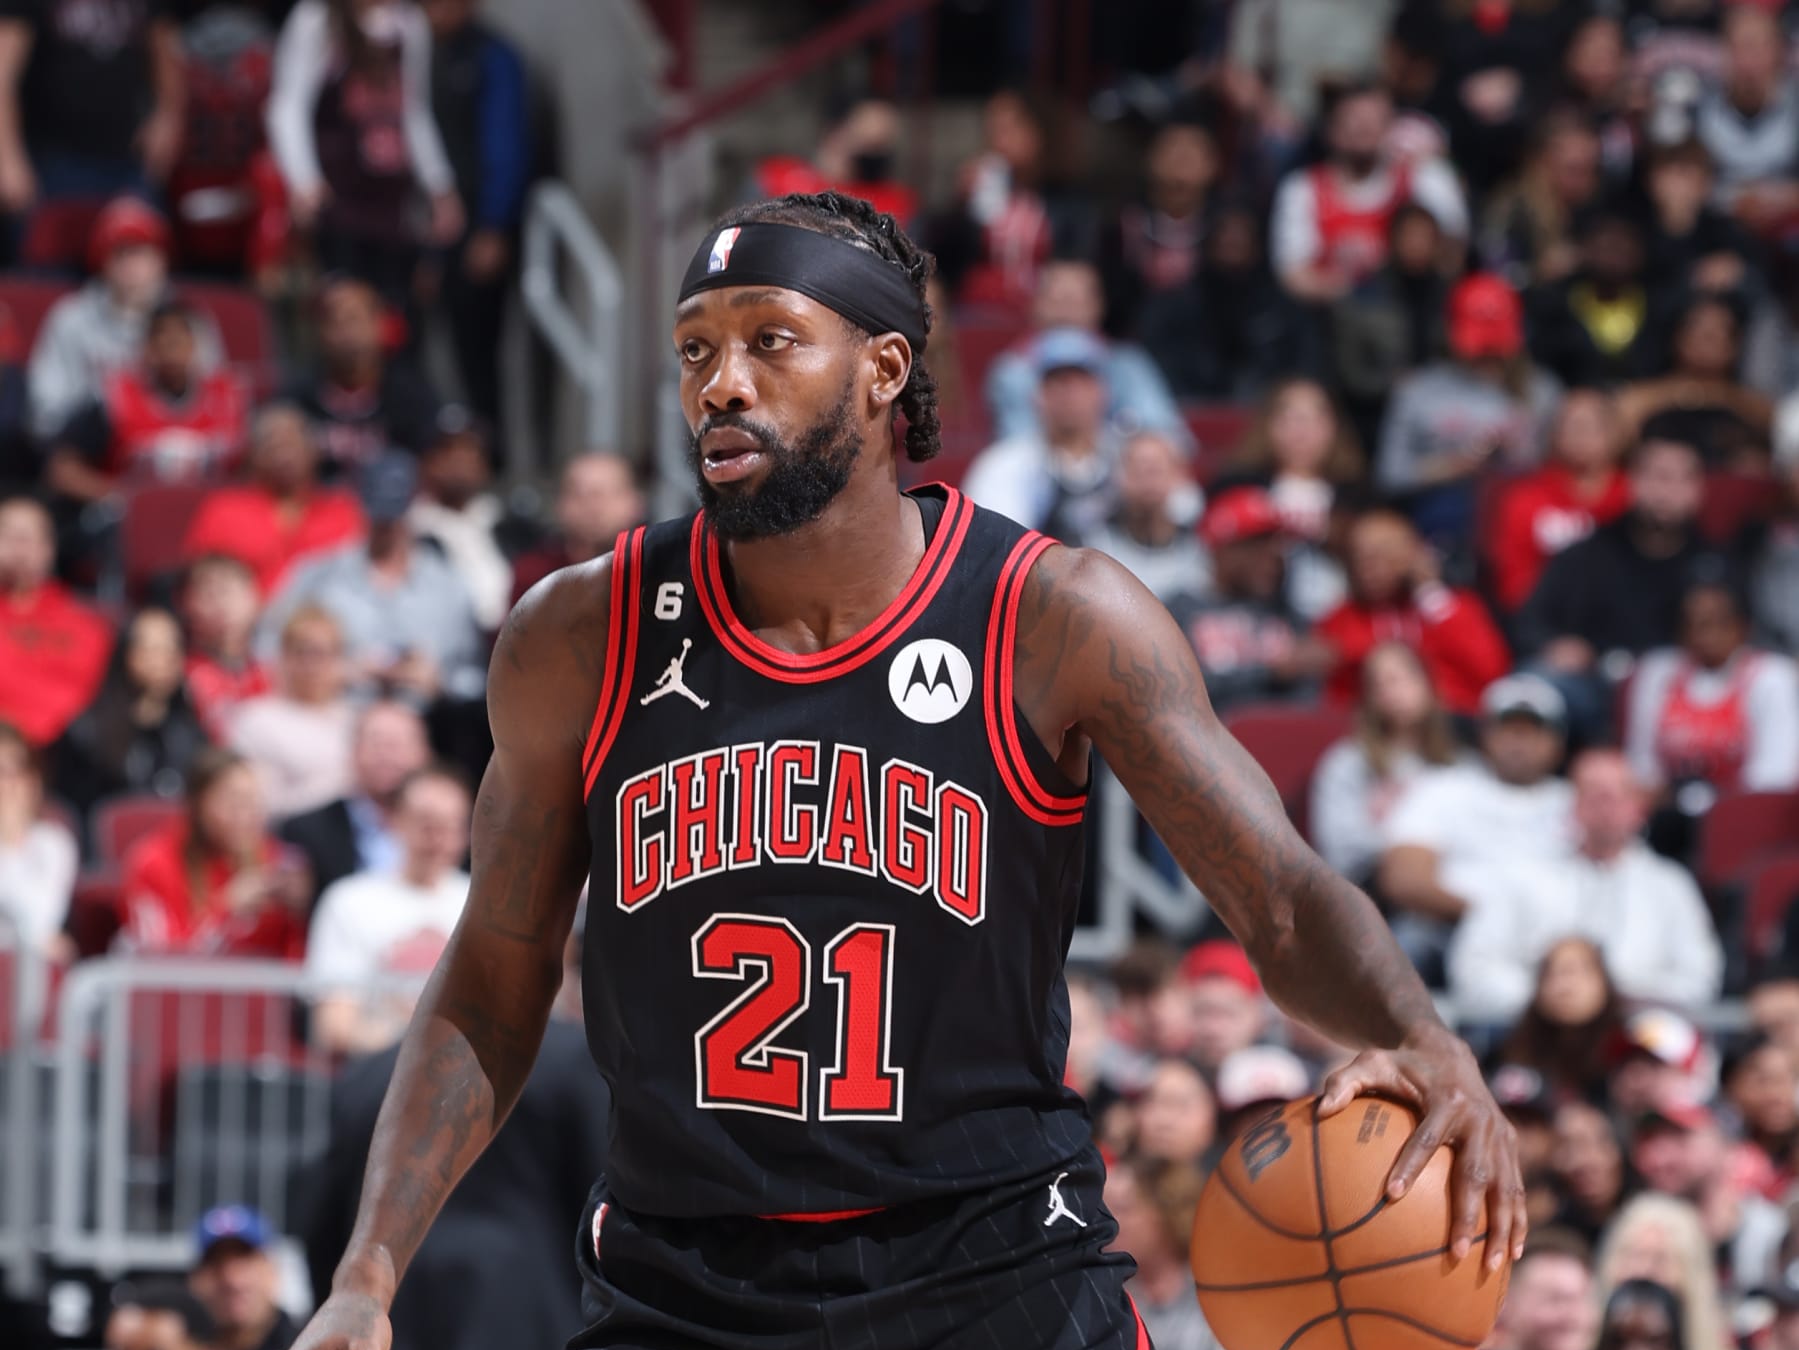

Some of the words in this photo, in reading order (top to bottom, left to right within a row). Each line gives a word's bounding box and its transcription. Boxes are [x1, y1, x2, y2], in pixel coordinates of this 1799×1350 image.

[653, 582, 684, 620] 6
[616, 740, 987, 925] CHICAGO
[691, 913, 903, 1121] 21
